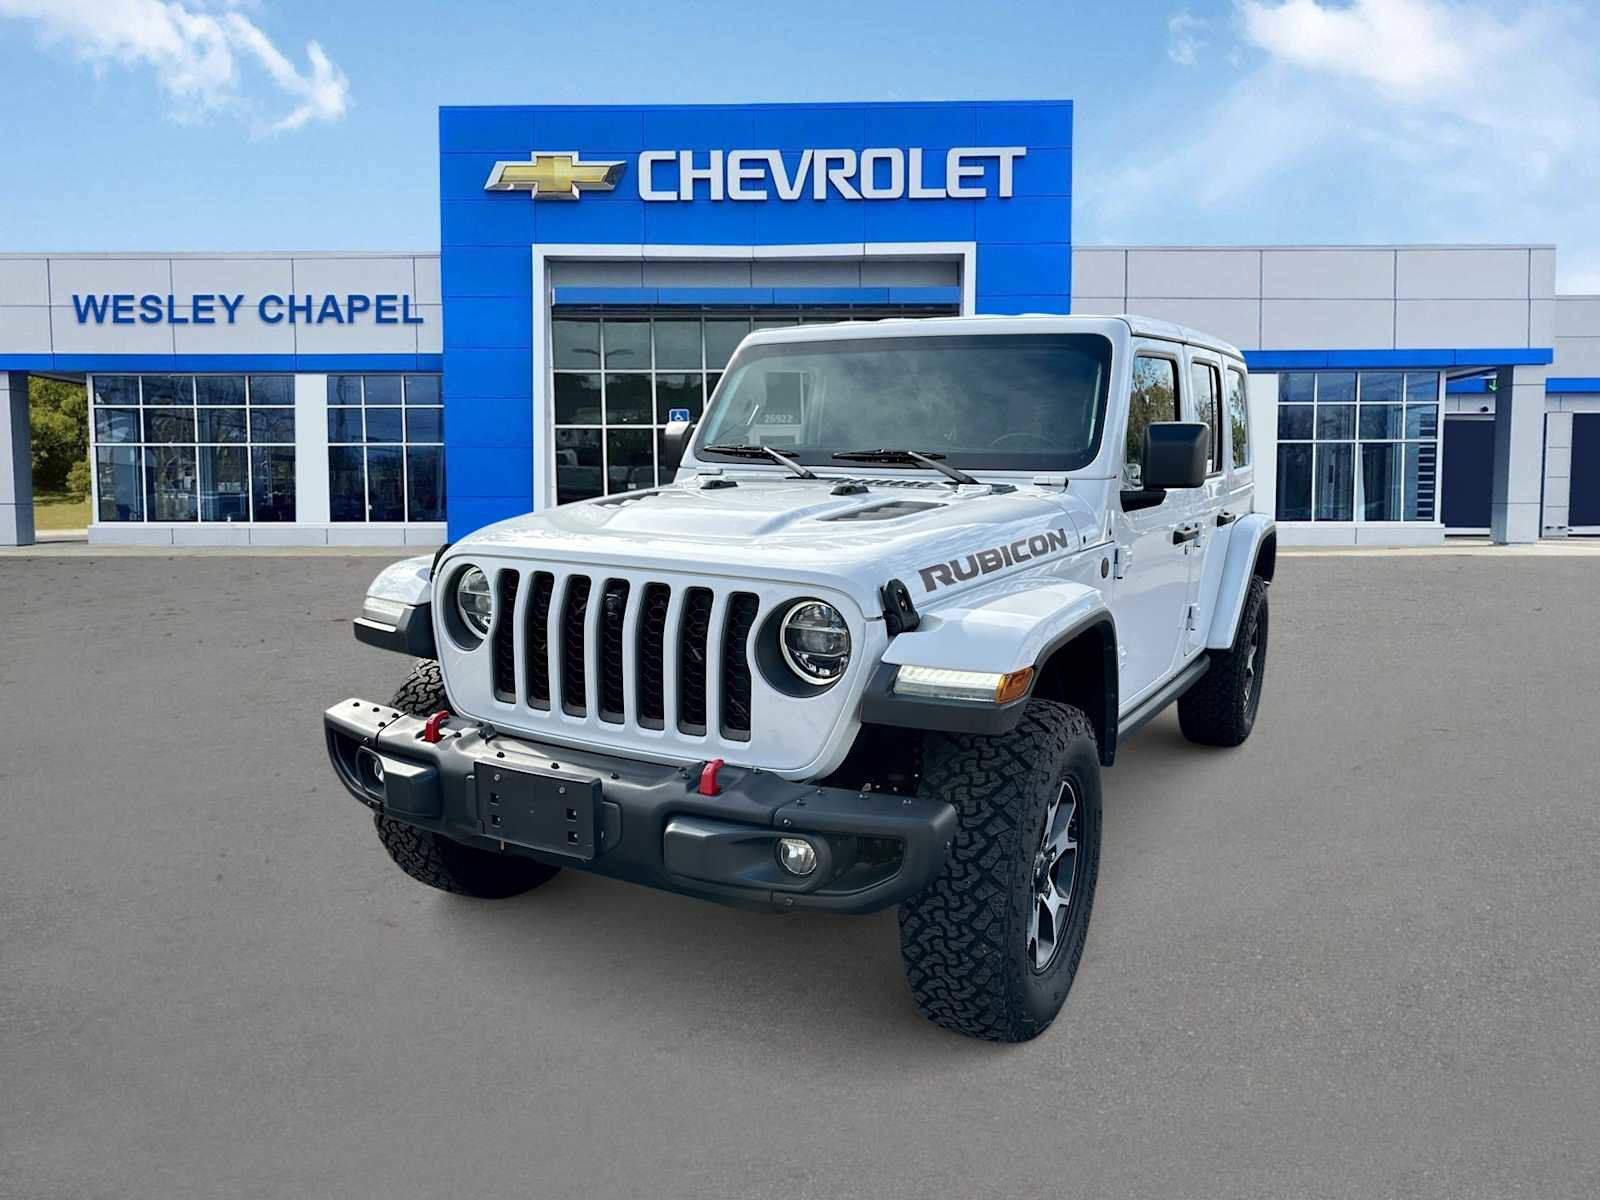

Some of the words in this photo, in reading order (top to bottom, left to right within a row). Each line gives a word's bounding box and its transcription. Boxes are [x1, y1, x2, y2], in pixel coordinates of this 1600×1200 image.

[638, 146, 1027, 202] CHEVROLET
[72, 294, 245, 324] WESLEY
[258, 294, 424, 324] CHAPEL
[918, 528, 1068, 593] RUBICON
